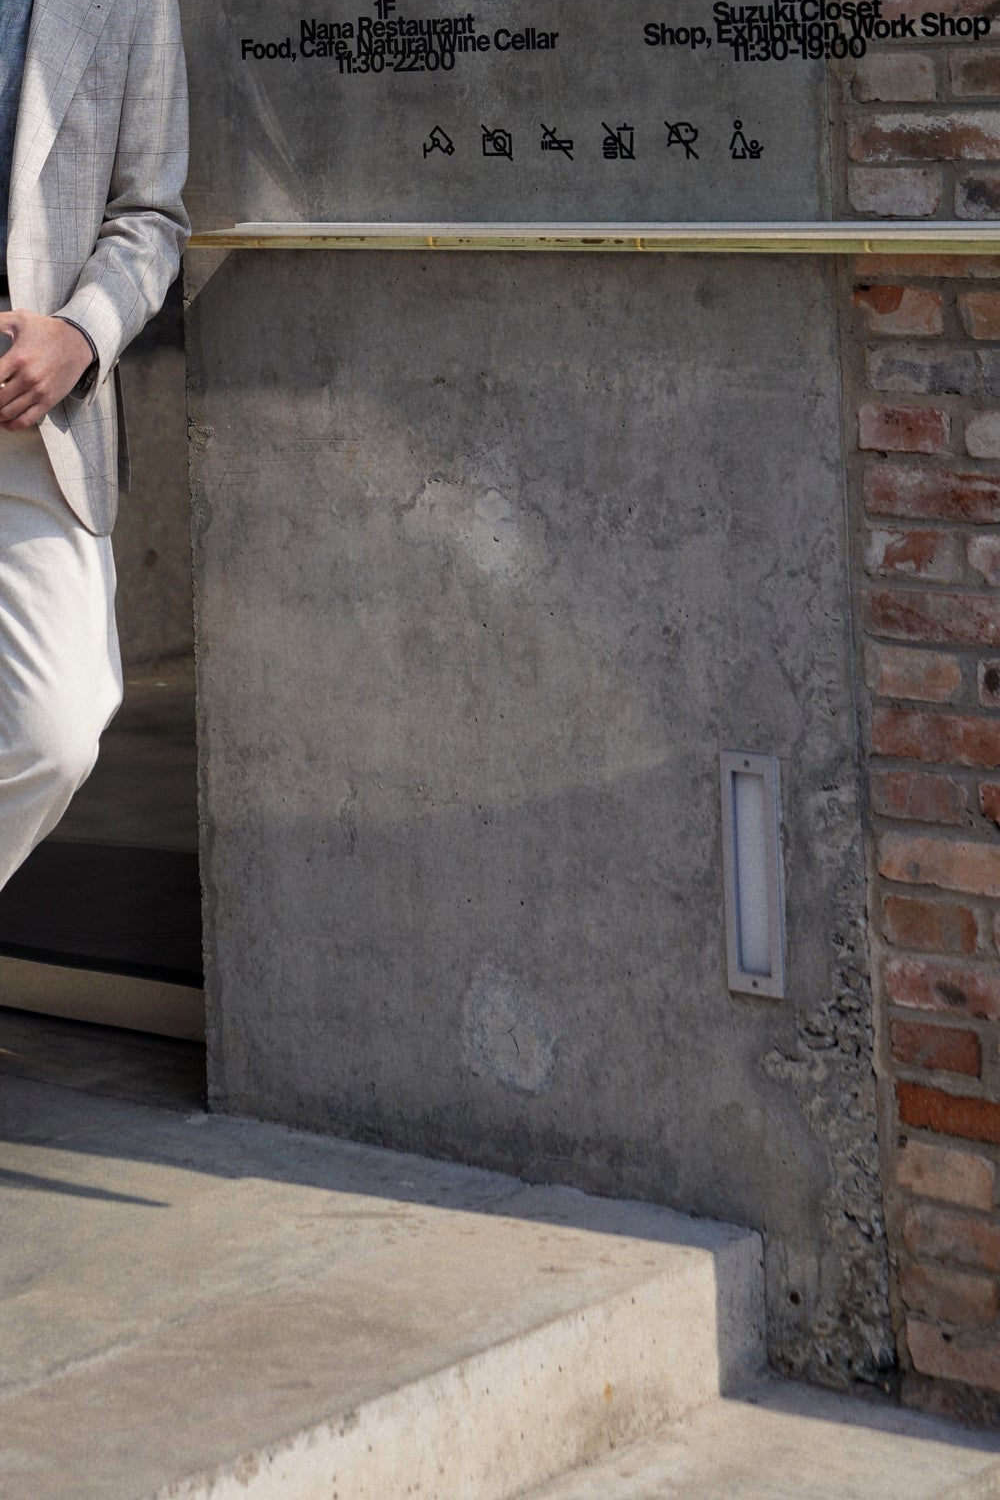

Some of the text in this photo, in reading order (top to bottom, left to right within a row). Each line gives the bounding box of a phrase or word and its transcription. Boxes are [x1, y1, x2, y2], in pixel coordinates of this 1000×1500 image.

[713, 0, 795, 25] Suzuki
[300, 14, 475, 40] Nana Restaurant
[644, 23, 711, 49] Shop,
[851, 14, 916, 39] Work
[921, 13, 990, 40] Shop
[241, 38, 296, 63] Food,
[357, 32, 433, 58] Natural
[437, 32, 490, 53] Wine
[494, 28, 559, 51] Cellar
[731, 35, 867, 62] 11:30-19:00
[336, 49, 455, 74] 11:30-22:00
